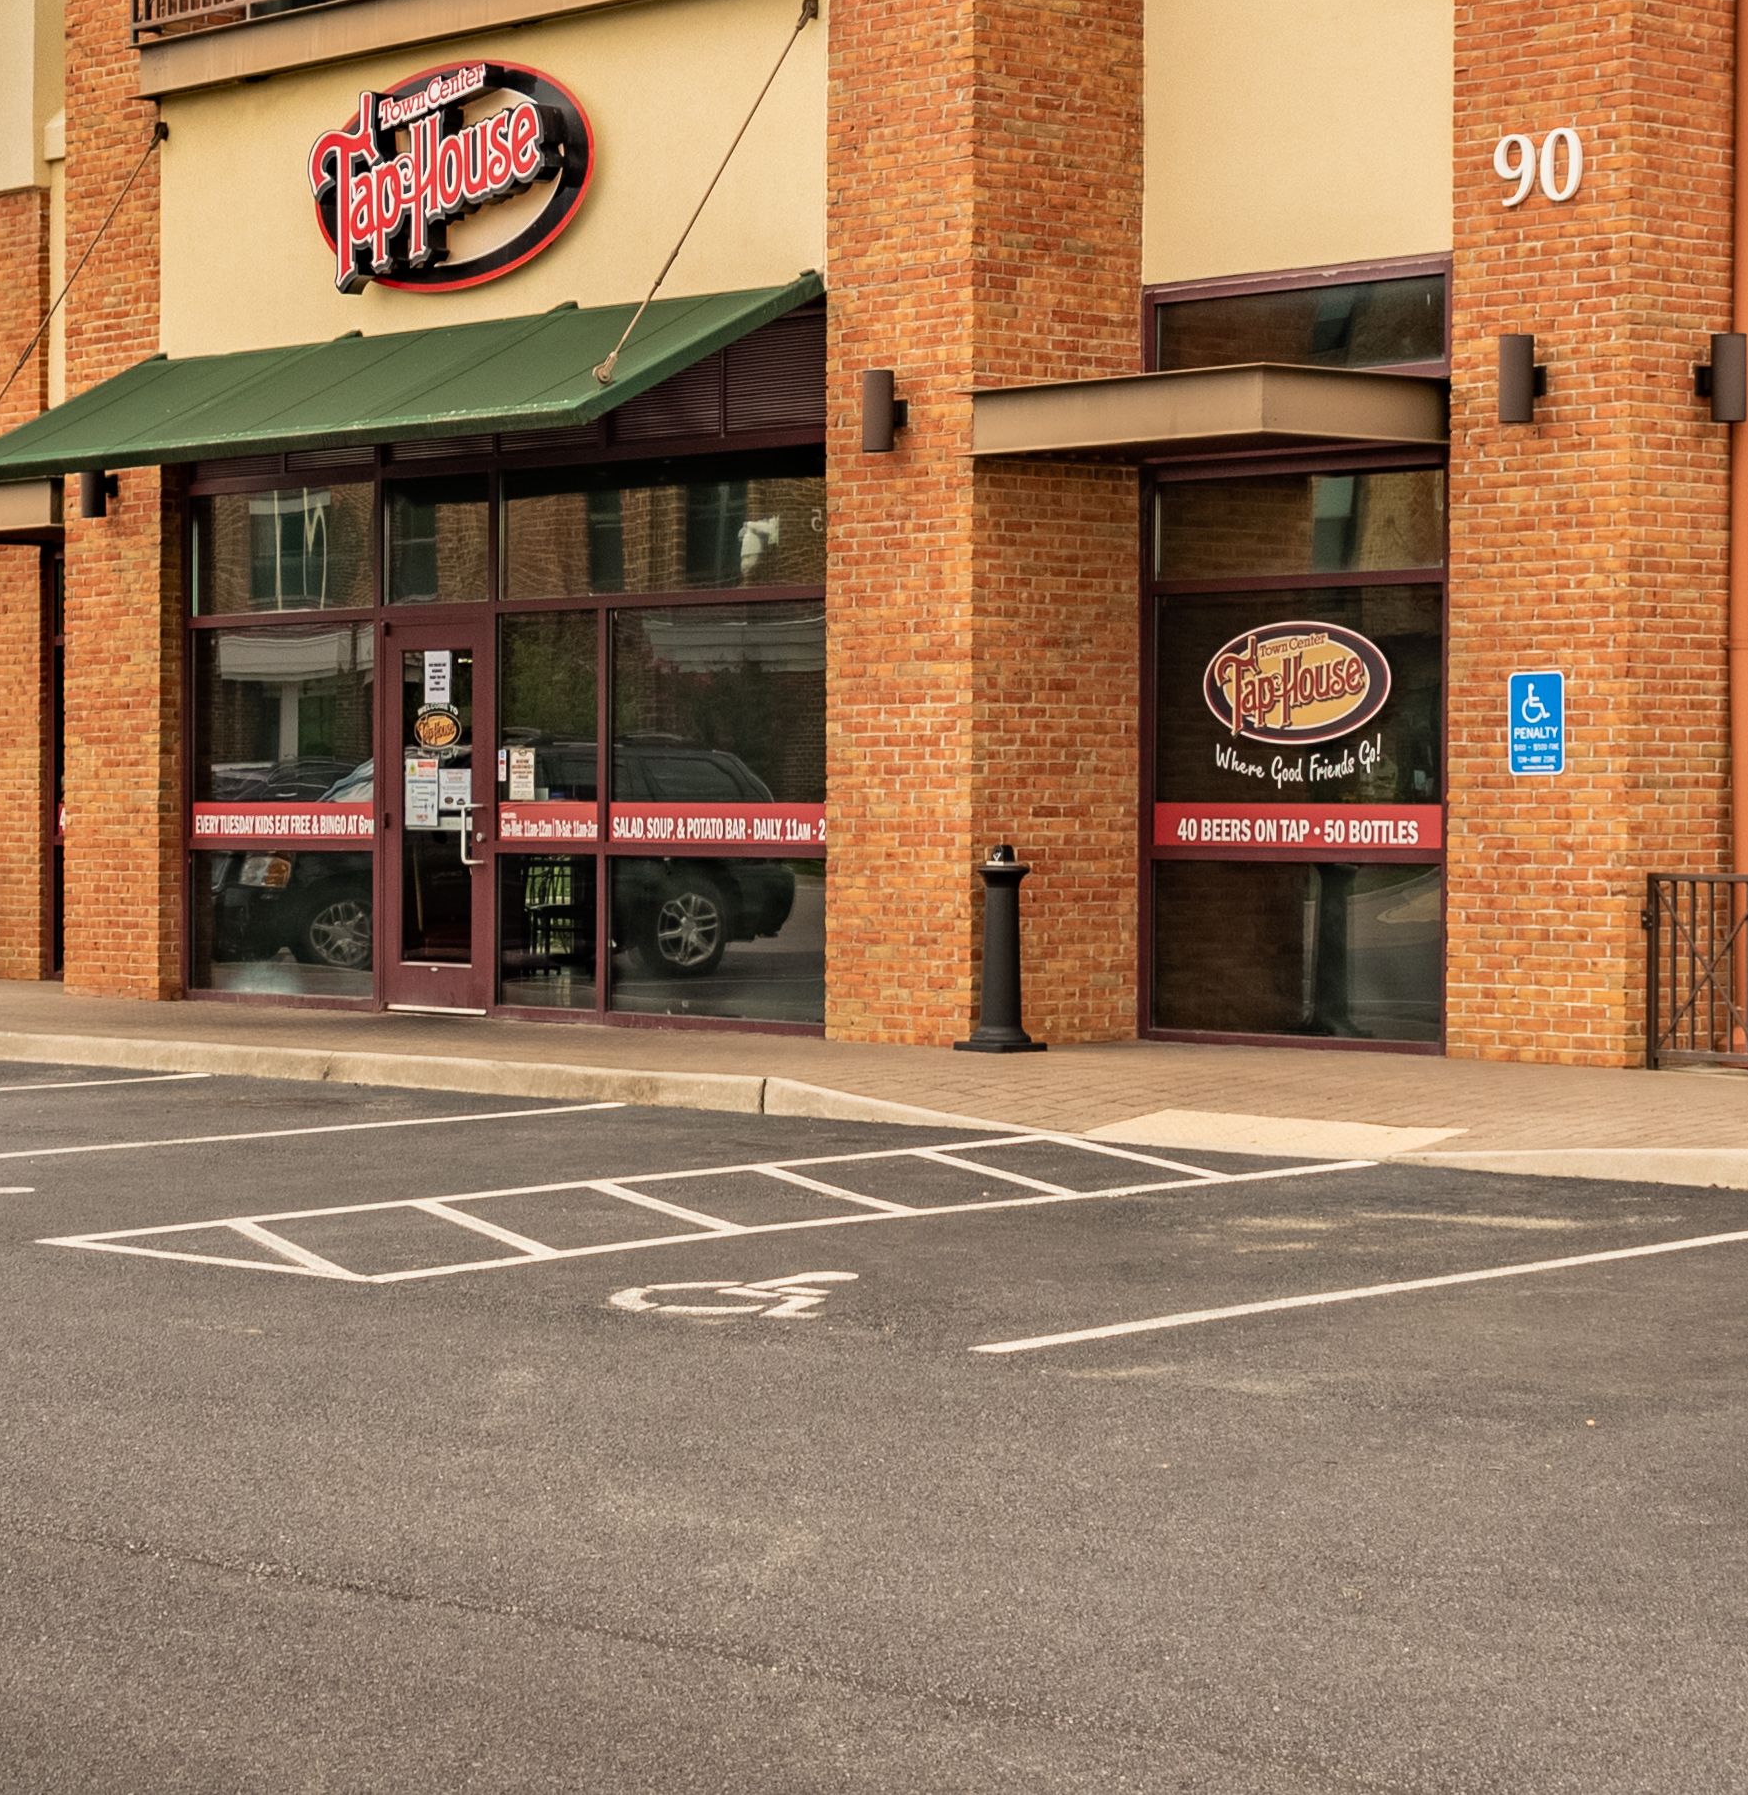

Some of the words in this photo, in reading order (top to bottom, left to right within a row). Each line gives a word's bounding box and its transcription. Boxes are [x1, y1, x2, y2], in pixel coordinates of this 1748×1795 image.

[379, 96, 425, 131] Town
[427, 64, 485, 105] Center
[1493, 127, 1583, 207] 90
[1258, 644, 1288, 658] Town
[1289, 634, 1327, 649] Center
[1514, 726, 1559, 739] PENALTY
[1215, 743, 1265, 778] Where
[1271, 756, 1303, 789] Good
[1309, 749, 1354, 782] Friends
[1358, 733, 1382, 773] Go!
[195, 814, 219, 834] EVERY
[220, 814, 254, 834] TUESDAY
[255, 814, 274, 834] KIDS
[275, 814, 289, 834] EAT
[290, 814, 311, 834] FREE
[311, 814, 319, 834] &
[320, 814, 347, 834] BINGO
[347, 814, 358, 834] AT
[613, 817, 645, 840] SALAD,
[647, 817, 675, 841] SOUP,
[676, 818, 685, 839] &
[686, 818, 723, 839] POTATO
[725, 818, 746, 840] BAR
[753, 818, 783, 842] DAILY,
[1177, 818, 1197, 841] 40
[1201, 818, 1251, 842] BEERS
[1254, 819, 1277, 842] ON
[1280, 819, 1309, 843] TAP
[1324, 819, 1345, 843] 50
[1349, 820, 1419, 844] BOTTLES
